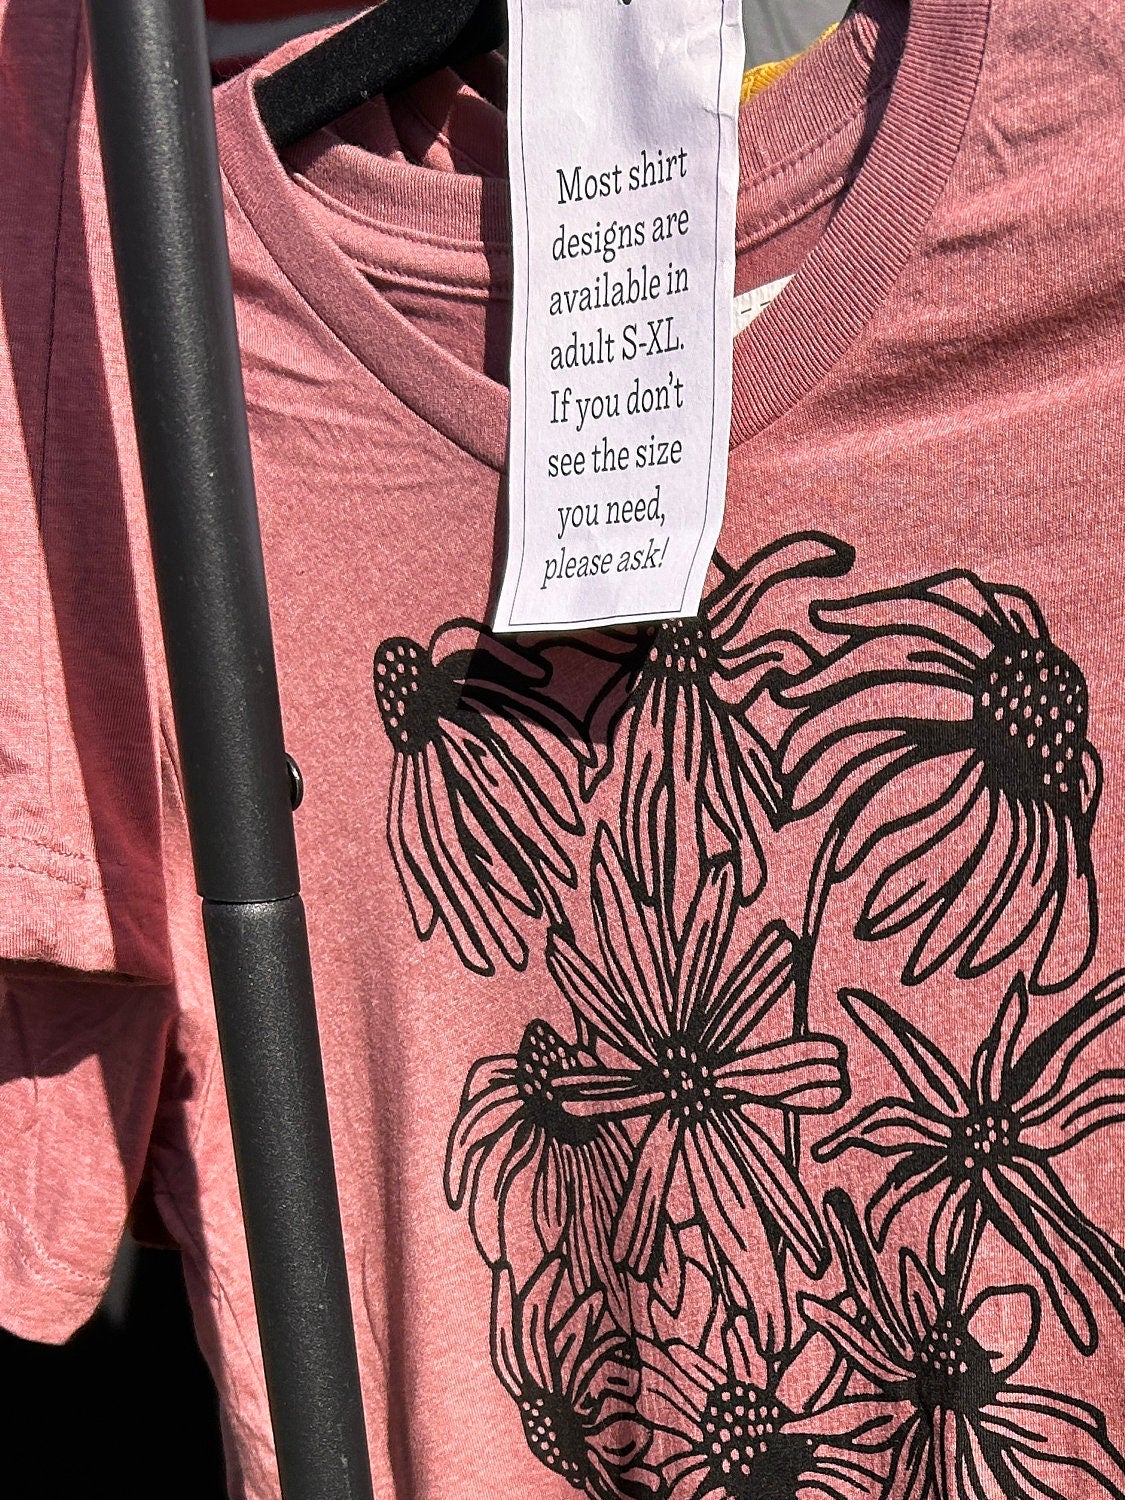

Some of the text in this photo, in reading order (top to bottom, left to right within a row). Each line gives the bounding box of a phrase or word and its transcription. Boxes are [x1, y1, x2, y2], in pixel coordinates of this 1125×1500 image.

[556, 147, 687, 204] Most shirt
[553, 210, 689, 263] designs are
[550, 262, 688, 316] available in
[551, 317, 684, 370] adult S-XL.
[550, 371, 684, 432] If you don't
[548, 435, 682, 477] see the size
[558, 485, 665, 539] you need,
[540, 537, 669, 590] please ask!
